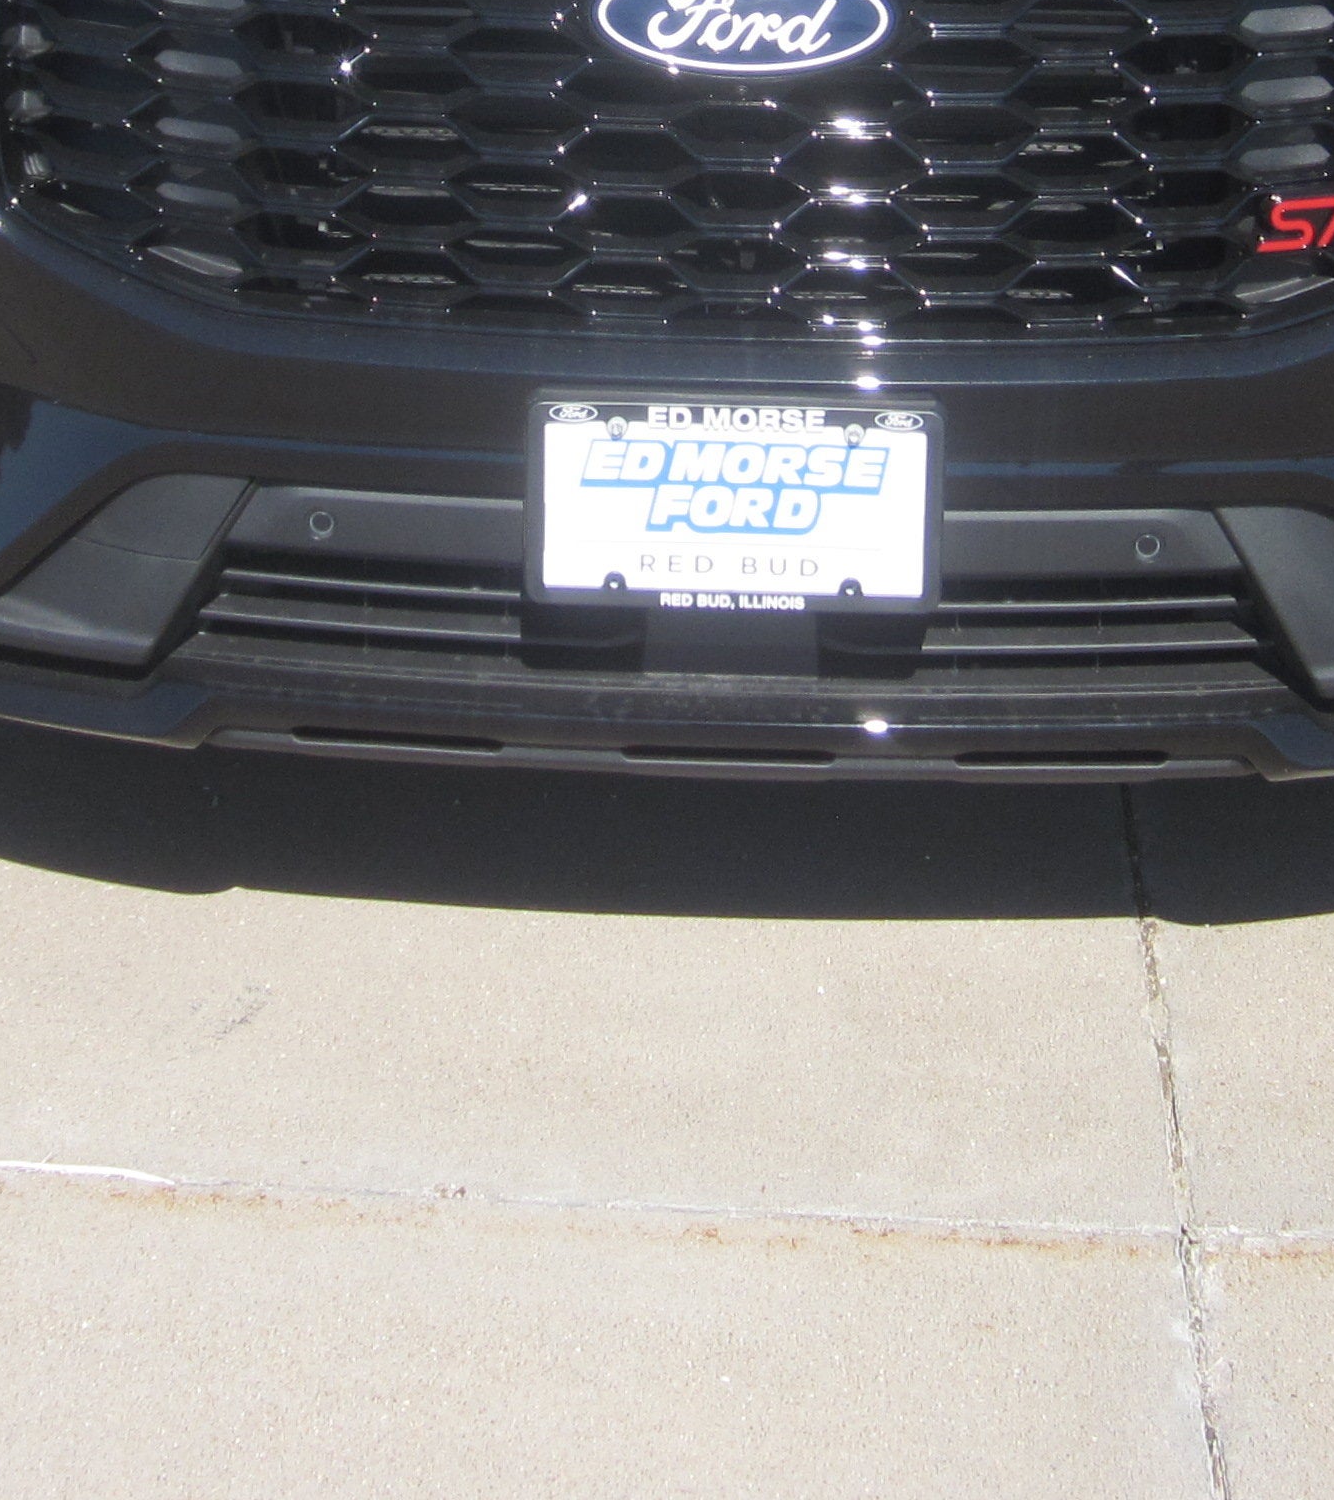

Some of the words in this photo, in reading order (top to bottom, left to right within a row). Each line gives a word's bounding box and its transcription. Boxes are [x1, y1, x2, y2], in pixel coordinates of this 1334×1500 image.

[647, 405, 692, 429] ED
[703, 407, 826, 432] MORSE
[582, 441, 667, 483] ED
[667, 441, 888, 491] MORSE
[649, 485, 820, 531] FORD
[640, 554, 714, 573] RED
[741, 557, 819, 577] BUD
[660, 592, 693, 607] RED
[696, 593, 735, 610] BUD,
[738, 594, 806, 610] ILLINOIS
